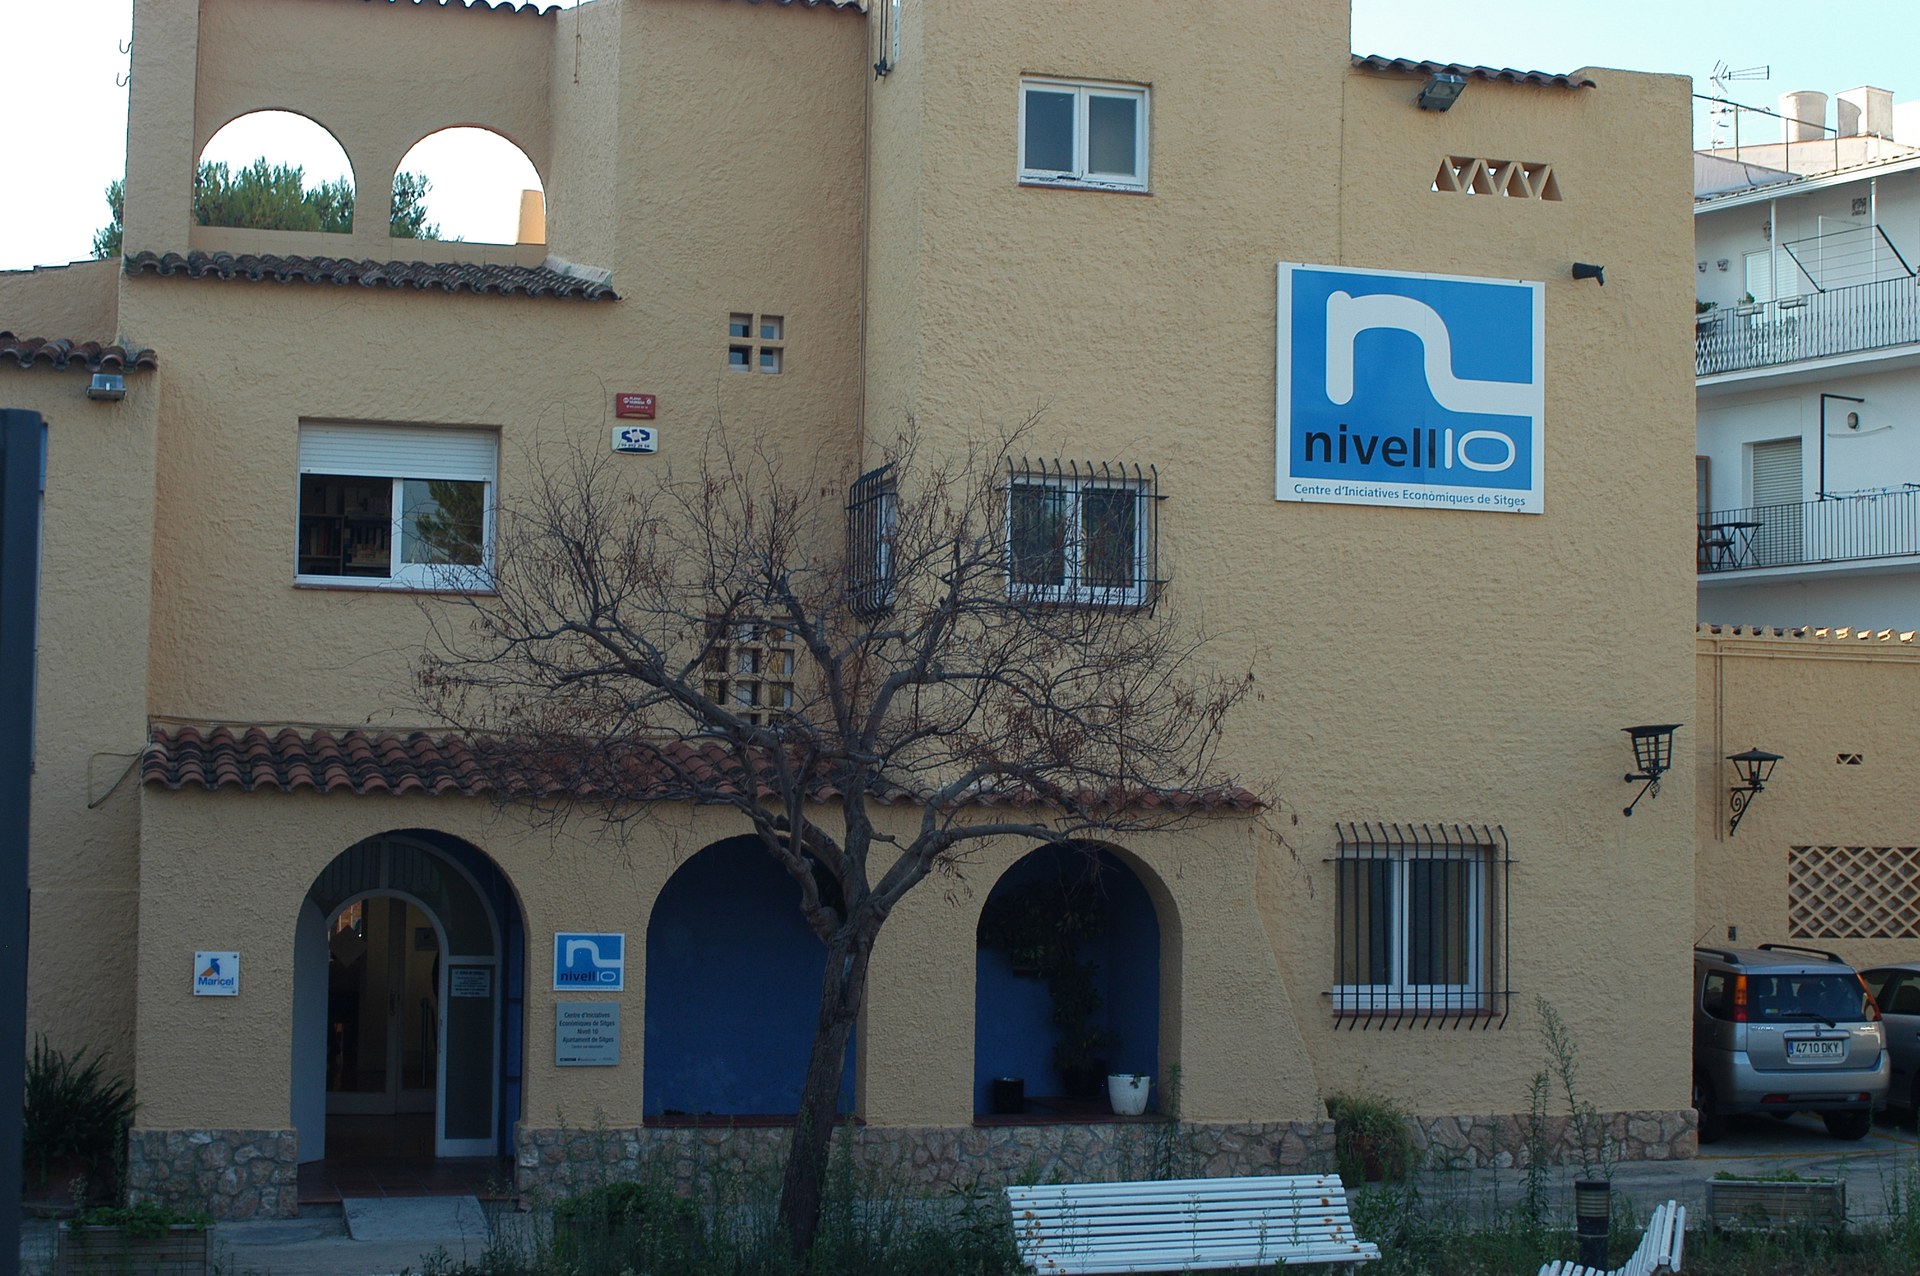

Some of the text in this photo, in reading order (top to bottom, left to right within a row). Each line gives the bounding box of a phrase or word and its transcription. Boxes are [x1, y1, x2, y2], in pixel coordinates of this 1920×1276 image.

[1294, 483, 1526, 507] Centre d'Iniciatives Econòmiques de Sitges
[198, 976, 234, 986] Maricel
[562, 1036, 590, 1044] Ajuntament
[599, 1036, 614, 1044] Sitges
[1796, 1042, 1839, 1054] 4710 DKY
